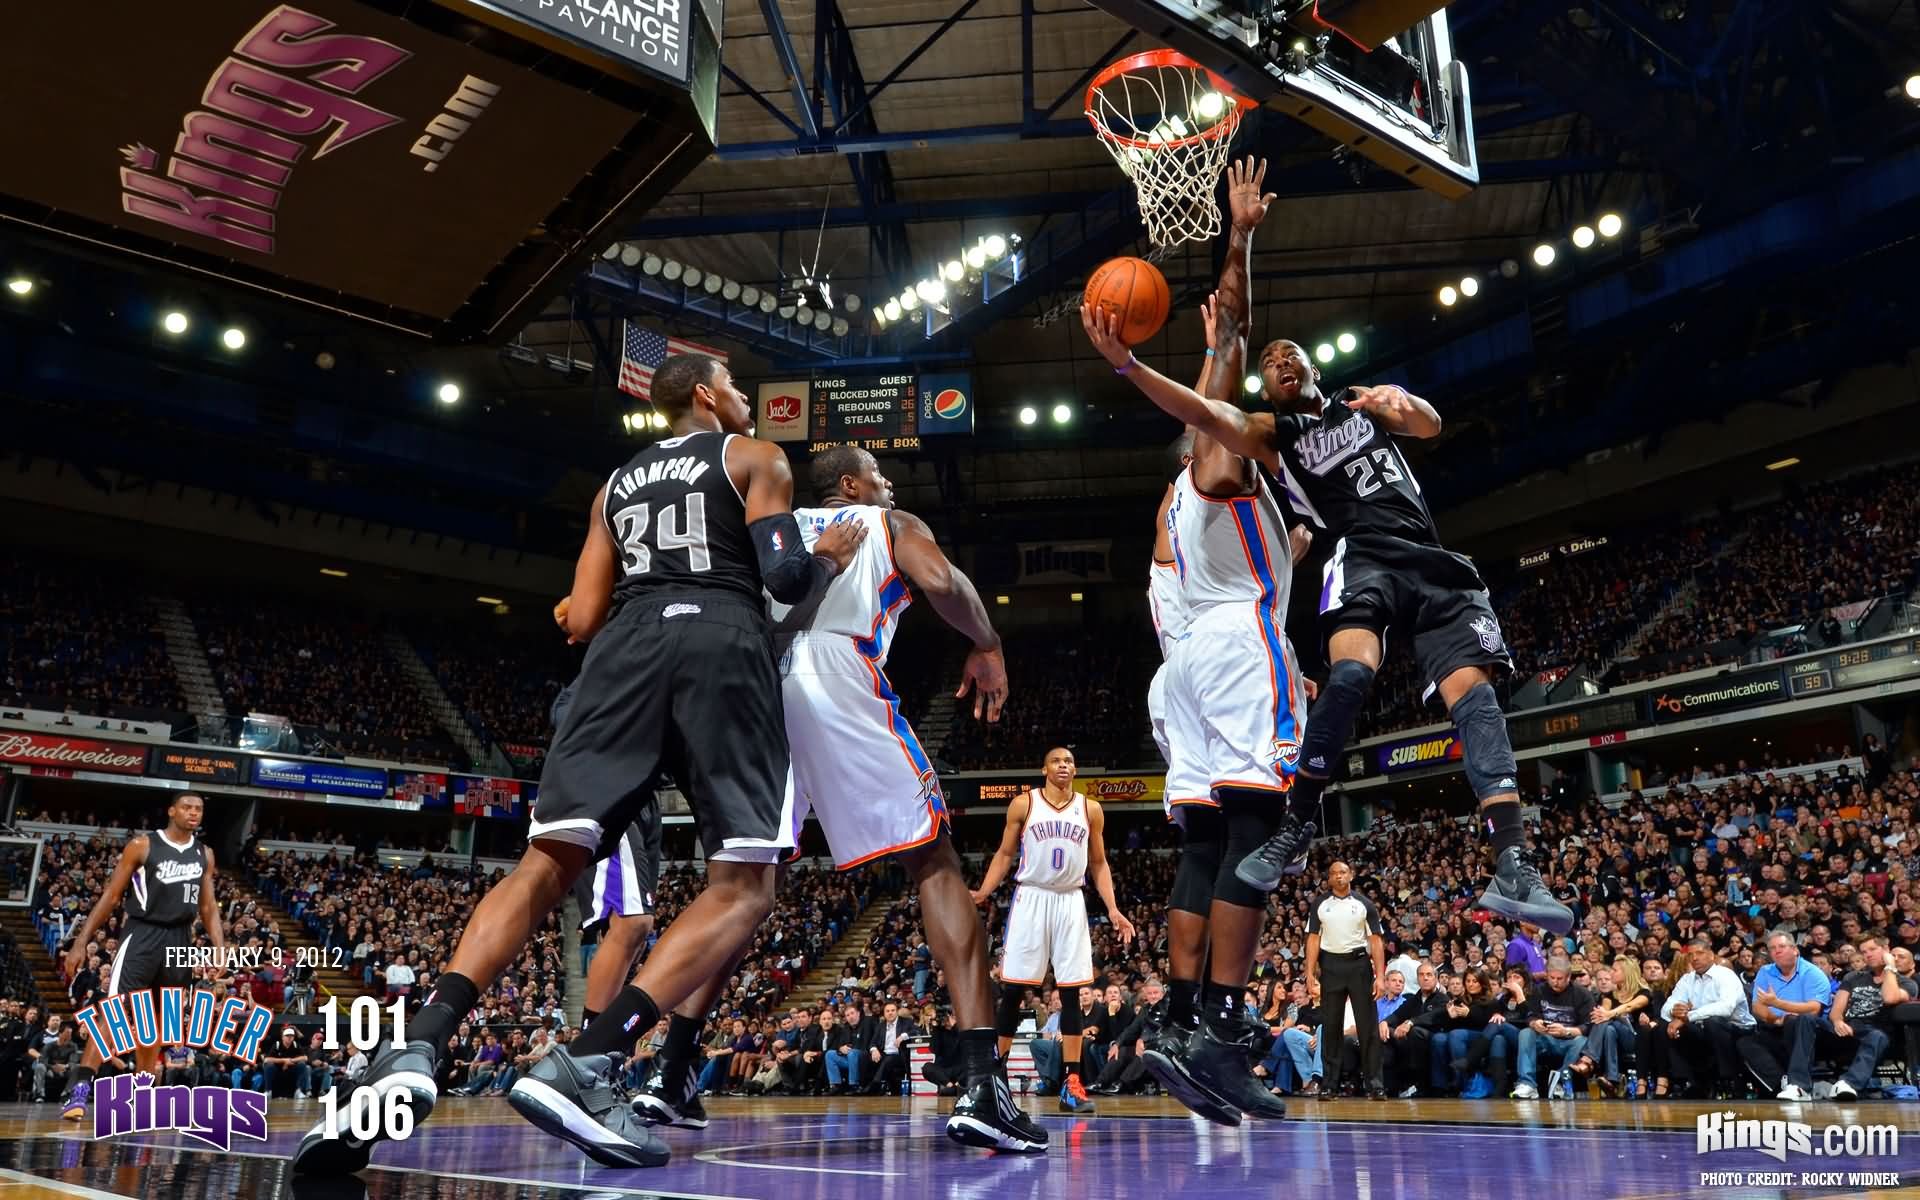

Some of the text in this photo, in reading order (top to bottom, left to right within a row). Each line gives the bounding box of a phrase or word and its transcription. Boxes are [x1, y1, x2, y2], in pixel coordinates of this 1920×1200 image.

[575, 0, 680, 49] LANCE
[814, 376, 914, 388] KINGS GUEST
[829, 391, 869, 400] BLOCKED
[869, 389, 898, 397] SHOTS
[838, 401, 892, 412] REBOUNDS
[923, 391, 933, 419] pepsi
[767, 398, 800, 420] Jack
[844, 414, 884, 425] STEALS
[864, 440, 888, 449] THE
[893, 438, 918, 448] BOX
[1294, 412, 1375, 477] Kings
[613, 456, 710, 500] THOMPSON
[1345, 448, 1404, 497] 23
[613, 492, 711, 577] 34
[1795, 662, 1820, 673] HOME
[1683, 680, 1780, 706] Communications
[0, 735, 143, 767] Budweiser
[1600, 734, 1615, 744] 102
[1387, 737, 1454, 767] SUBWAY
[1029, 821, 1087, 847] THUNDER
[1052, 846, 1065, 870] 0
[156, 860, 203, 884] Kings
[183, 883, 200, 904] 13
